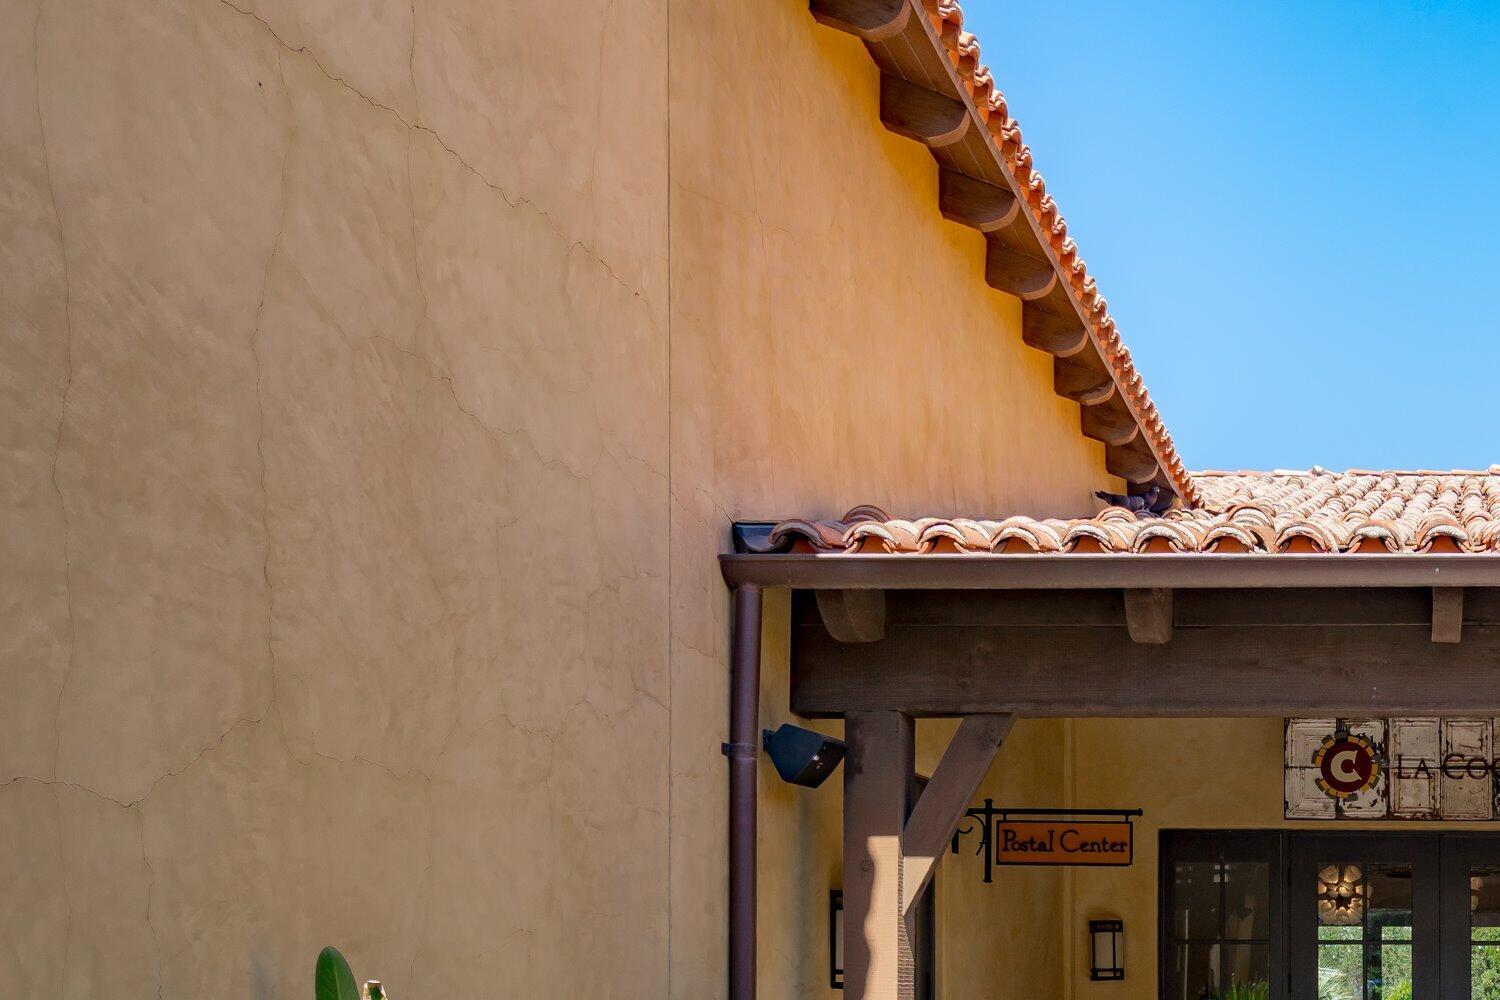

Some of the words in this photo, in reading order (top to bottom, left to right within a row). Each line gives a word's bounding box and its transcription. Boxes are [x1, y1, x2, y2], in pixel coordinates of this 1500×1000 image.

[1330, 750, 1362, 783] C
[1397, 754, 1432, 780] LA
[1001, 829, 1055, 853] Postal
[1060, 829, 1128, 854] Center
